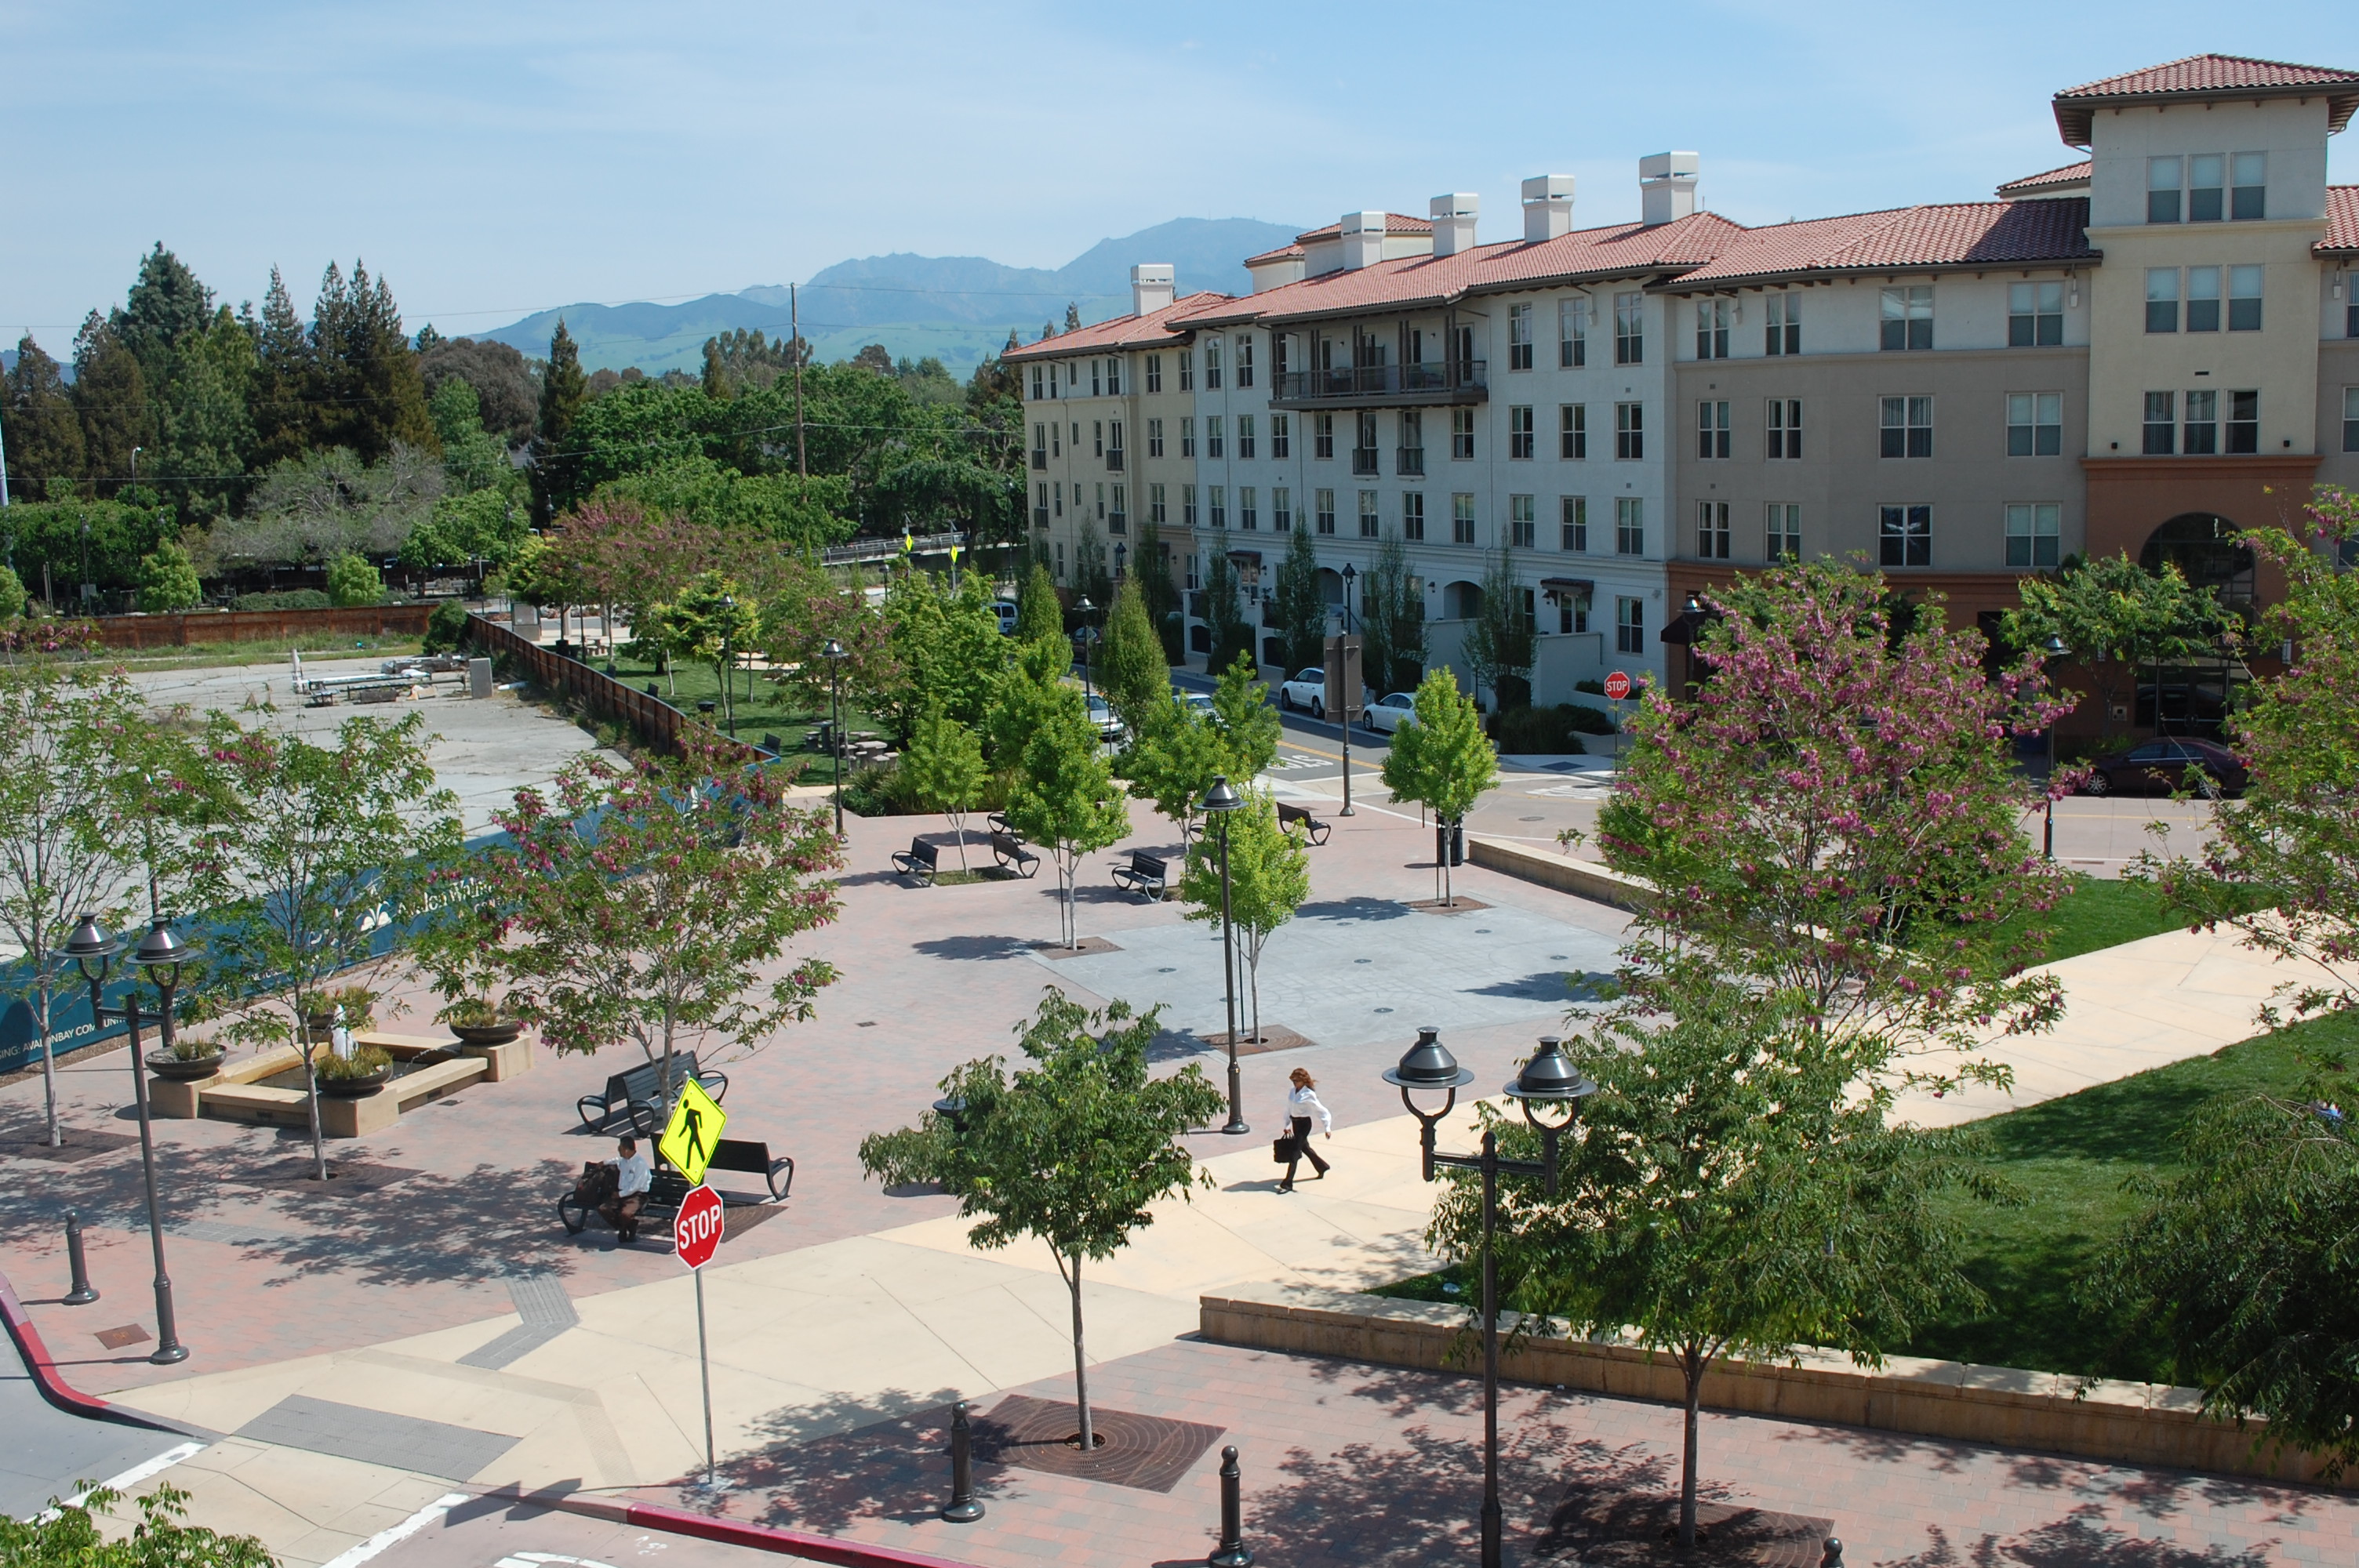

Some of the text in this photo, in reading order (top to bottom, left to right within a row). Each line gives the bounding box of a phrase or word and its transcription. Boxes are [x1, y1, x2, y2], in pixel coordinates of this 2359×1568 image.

[1606, 681, 1628, 692] STOP
[23, 1029, 75, 1052] AVALNBAY
[679, 1204, 720, 1250] STOP
